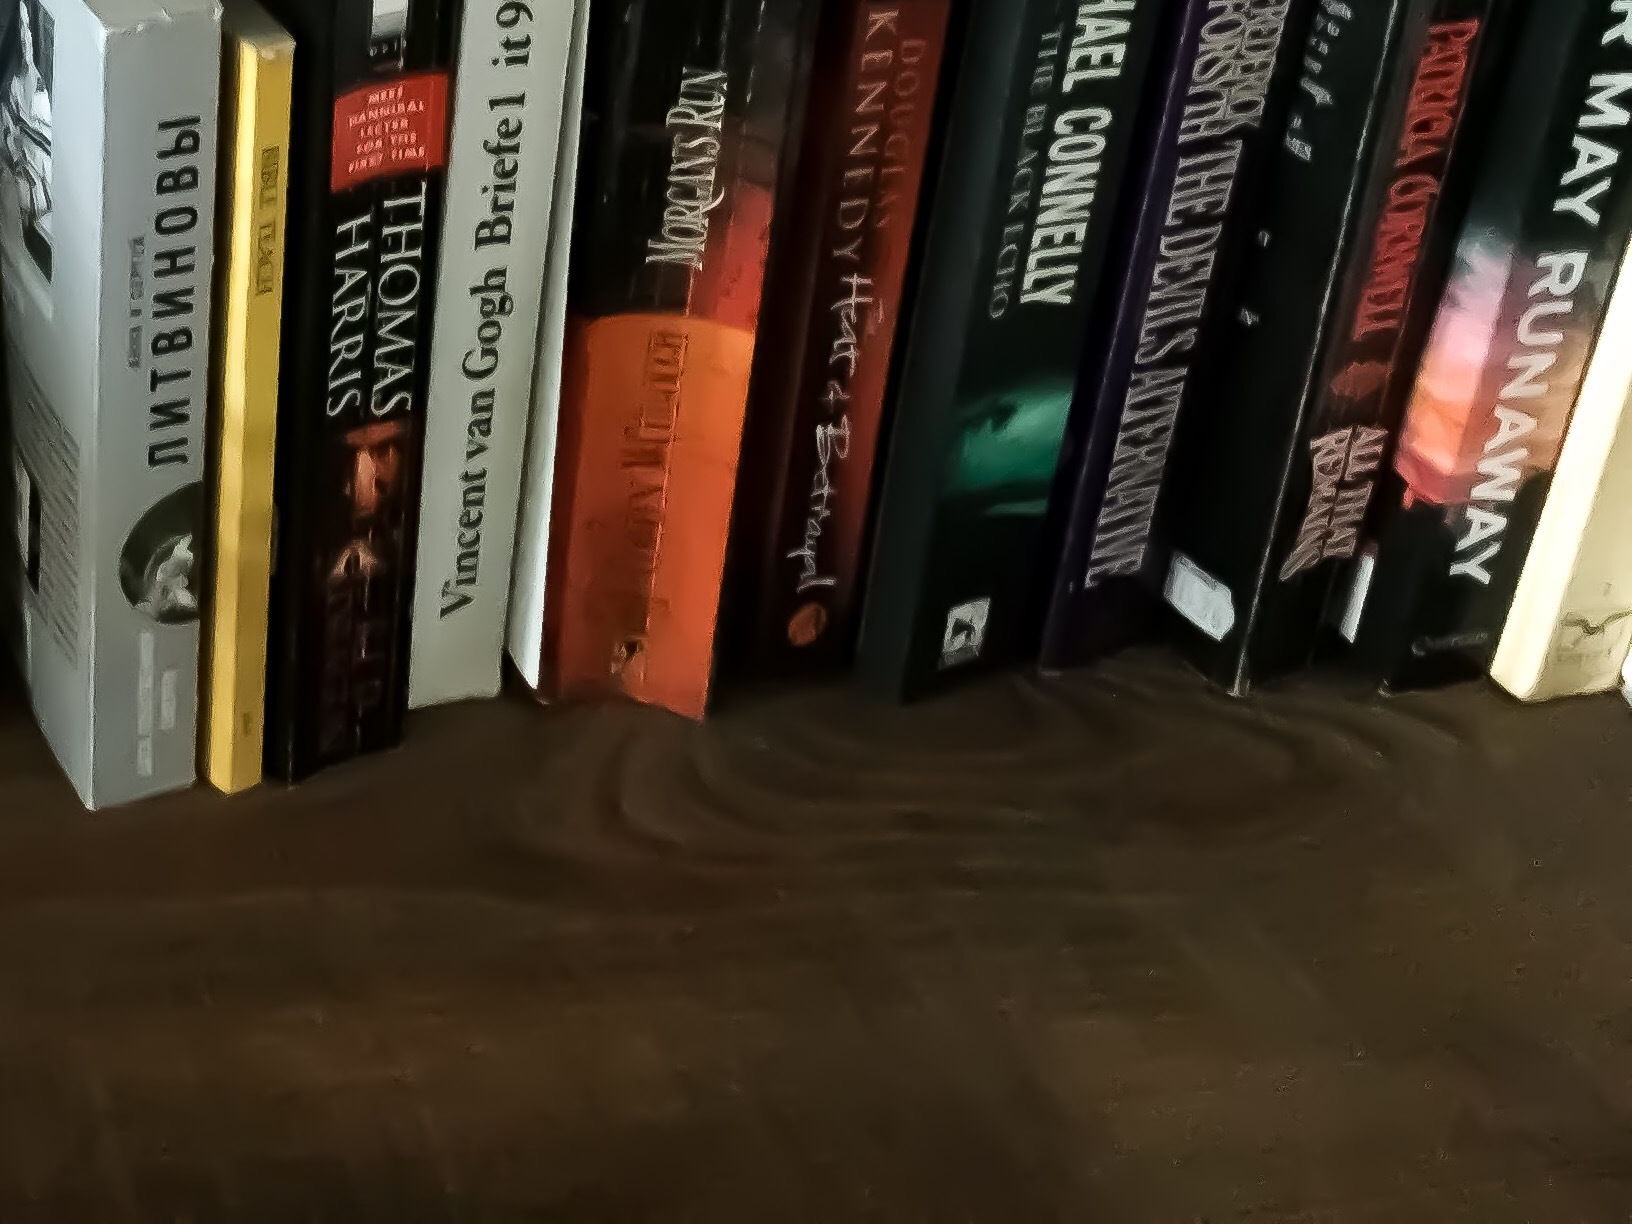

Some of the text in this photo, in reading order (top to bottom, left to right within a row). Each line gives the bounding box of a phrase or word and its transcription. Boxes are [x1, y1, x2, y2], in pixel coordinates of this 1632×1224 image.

[491, 31, 533, 69] it
[1028, 21, 1066, 97] THE
[473, 115, 524, 251] Briefe
[831, 7, 902, 267] KENNEDY
[1006, 102, 1049, 216] BLACK
[1018, 104, 1113, 305] CONNELLY
[1164, 137, 1246, 226] THE
[1552, 71, 1632, 229] MAY
[147, 114, 202, 471] ЛИТВИНОВЫ
[325, 212, 373, 418] HARRIS
[370, 180, 427, 418] THOMAS
[461, 264, 513, 381] Gogh
[465, 387, 498, 460] van
[1447, 250, 1590, 586] RUNAWAY
[439, 466, 489, 621] Vincent
